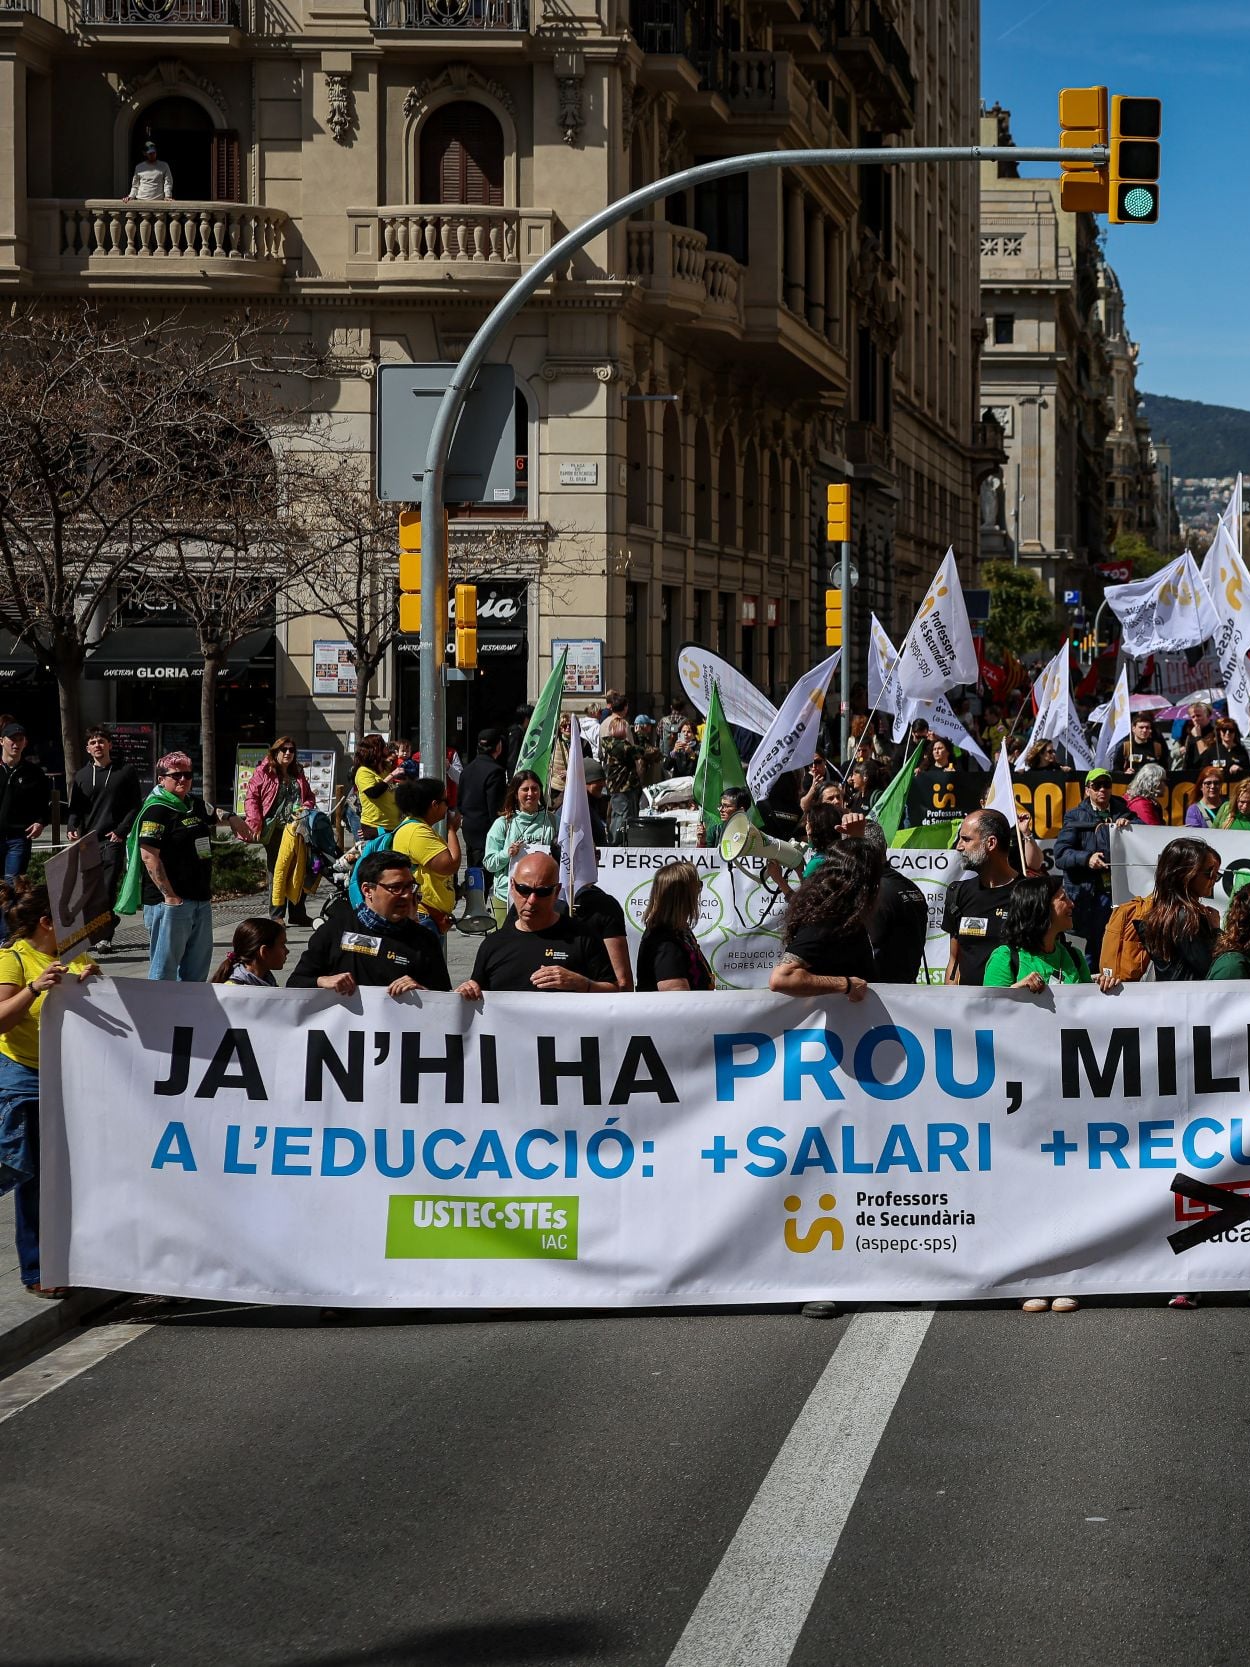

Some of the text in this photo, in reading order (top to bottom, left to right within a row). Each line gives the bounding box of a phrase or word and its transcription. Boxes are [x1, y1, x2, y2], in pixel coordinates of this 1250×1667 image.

[137, 667, 189, 678] GLORIA
[724, 961, 774, 970] HORES ALS
[153, 1026, 268, 1101] JA
[537, 1035, 680, 1106] HA
[713, 1024, 1023, 1115] PROU,
[150, 1121, 198, 1172] A
[701, 1122, 993, 1178] +SALARI
[856, 1191, 948, 1207] Professors
[856, 1210, 976, 1227] de Secundària
[542, 1234, 568, 1250] IAC
